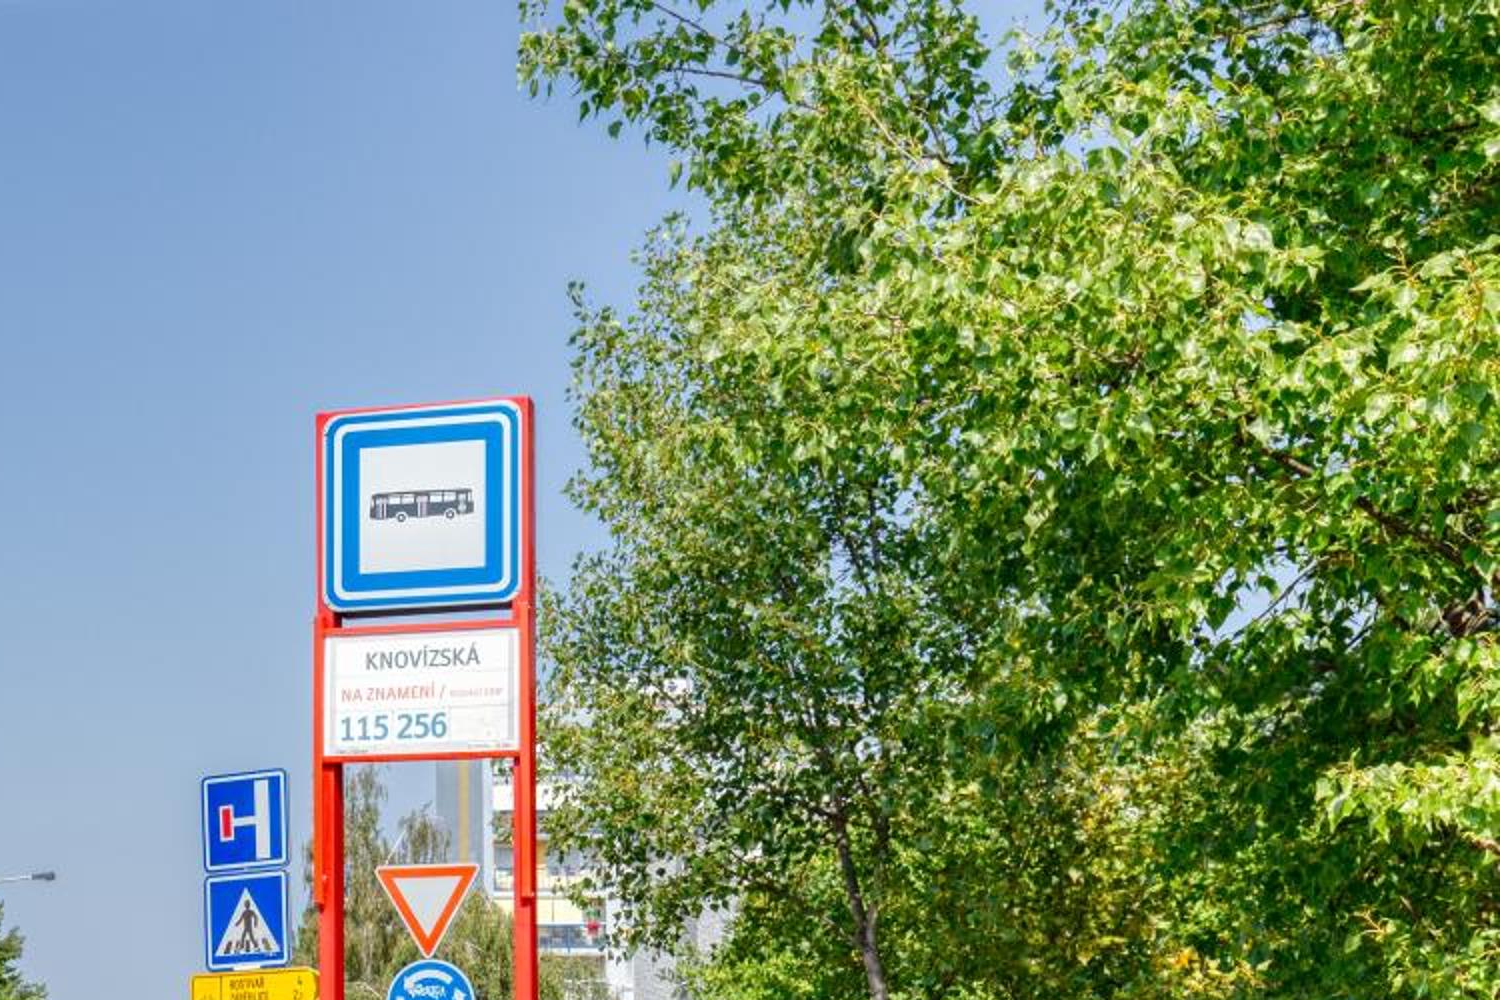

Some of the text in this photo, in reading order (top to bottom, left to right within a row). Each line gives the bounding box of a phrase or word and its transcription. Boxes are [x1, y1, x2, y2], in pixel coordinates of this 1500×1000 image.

[365, 642, 480, 670] KNOVÍZSKÁ
[341, 688, 363, 702] NA
[366, 681, 435, 702] ZNAMENÍ
[341, 712, 447, 742] 115 256
